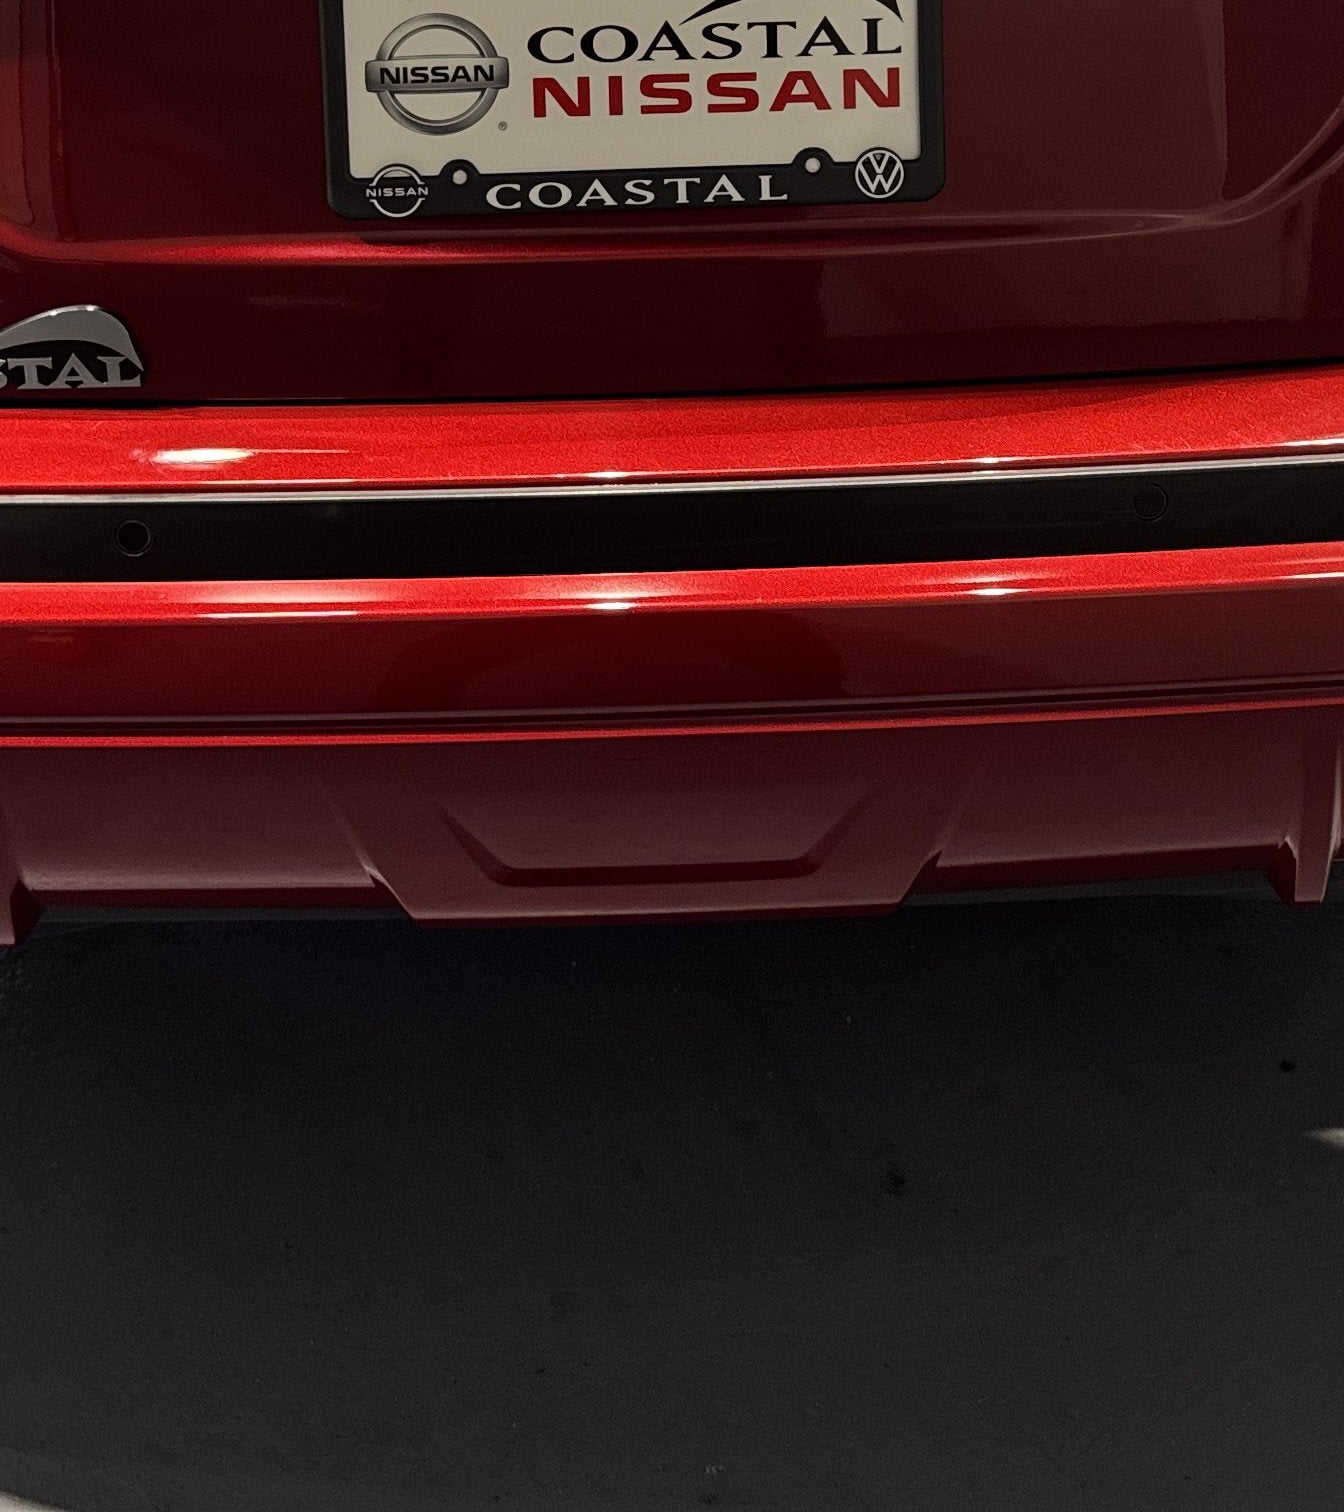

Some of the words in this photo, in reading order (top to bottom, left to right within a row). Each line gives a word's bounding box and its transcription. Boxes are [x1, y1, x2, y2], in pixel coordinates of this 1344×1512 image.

[527, 16, 903, 64] COASTAL
[379, 63, 495, 86] NISSAN
[532, 66, 902, 118] NISSAN
[365, 186, 429, 198] NISSAN
[486, 175, 789, 210] COASTAL
